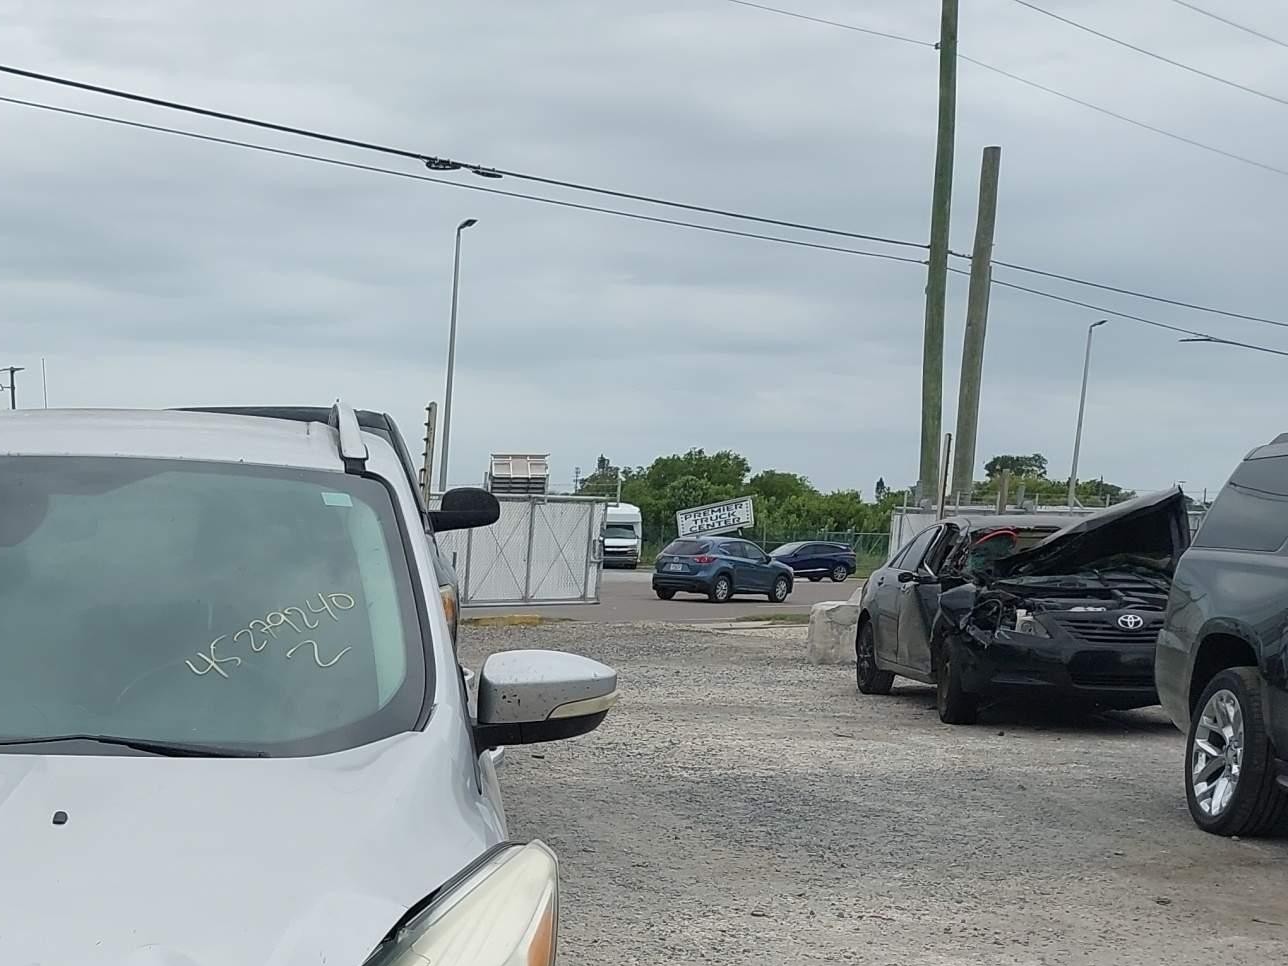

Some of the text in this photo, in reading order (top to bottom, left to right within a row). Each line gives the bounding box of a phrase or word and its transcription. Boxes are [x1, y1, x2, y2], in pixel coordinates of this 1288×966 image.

[684, 503, 743, 521] PREMIER
[692, 510, 736, 525] TRUCK
[689, 516, 741, 532] CENTER
